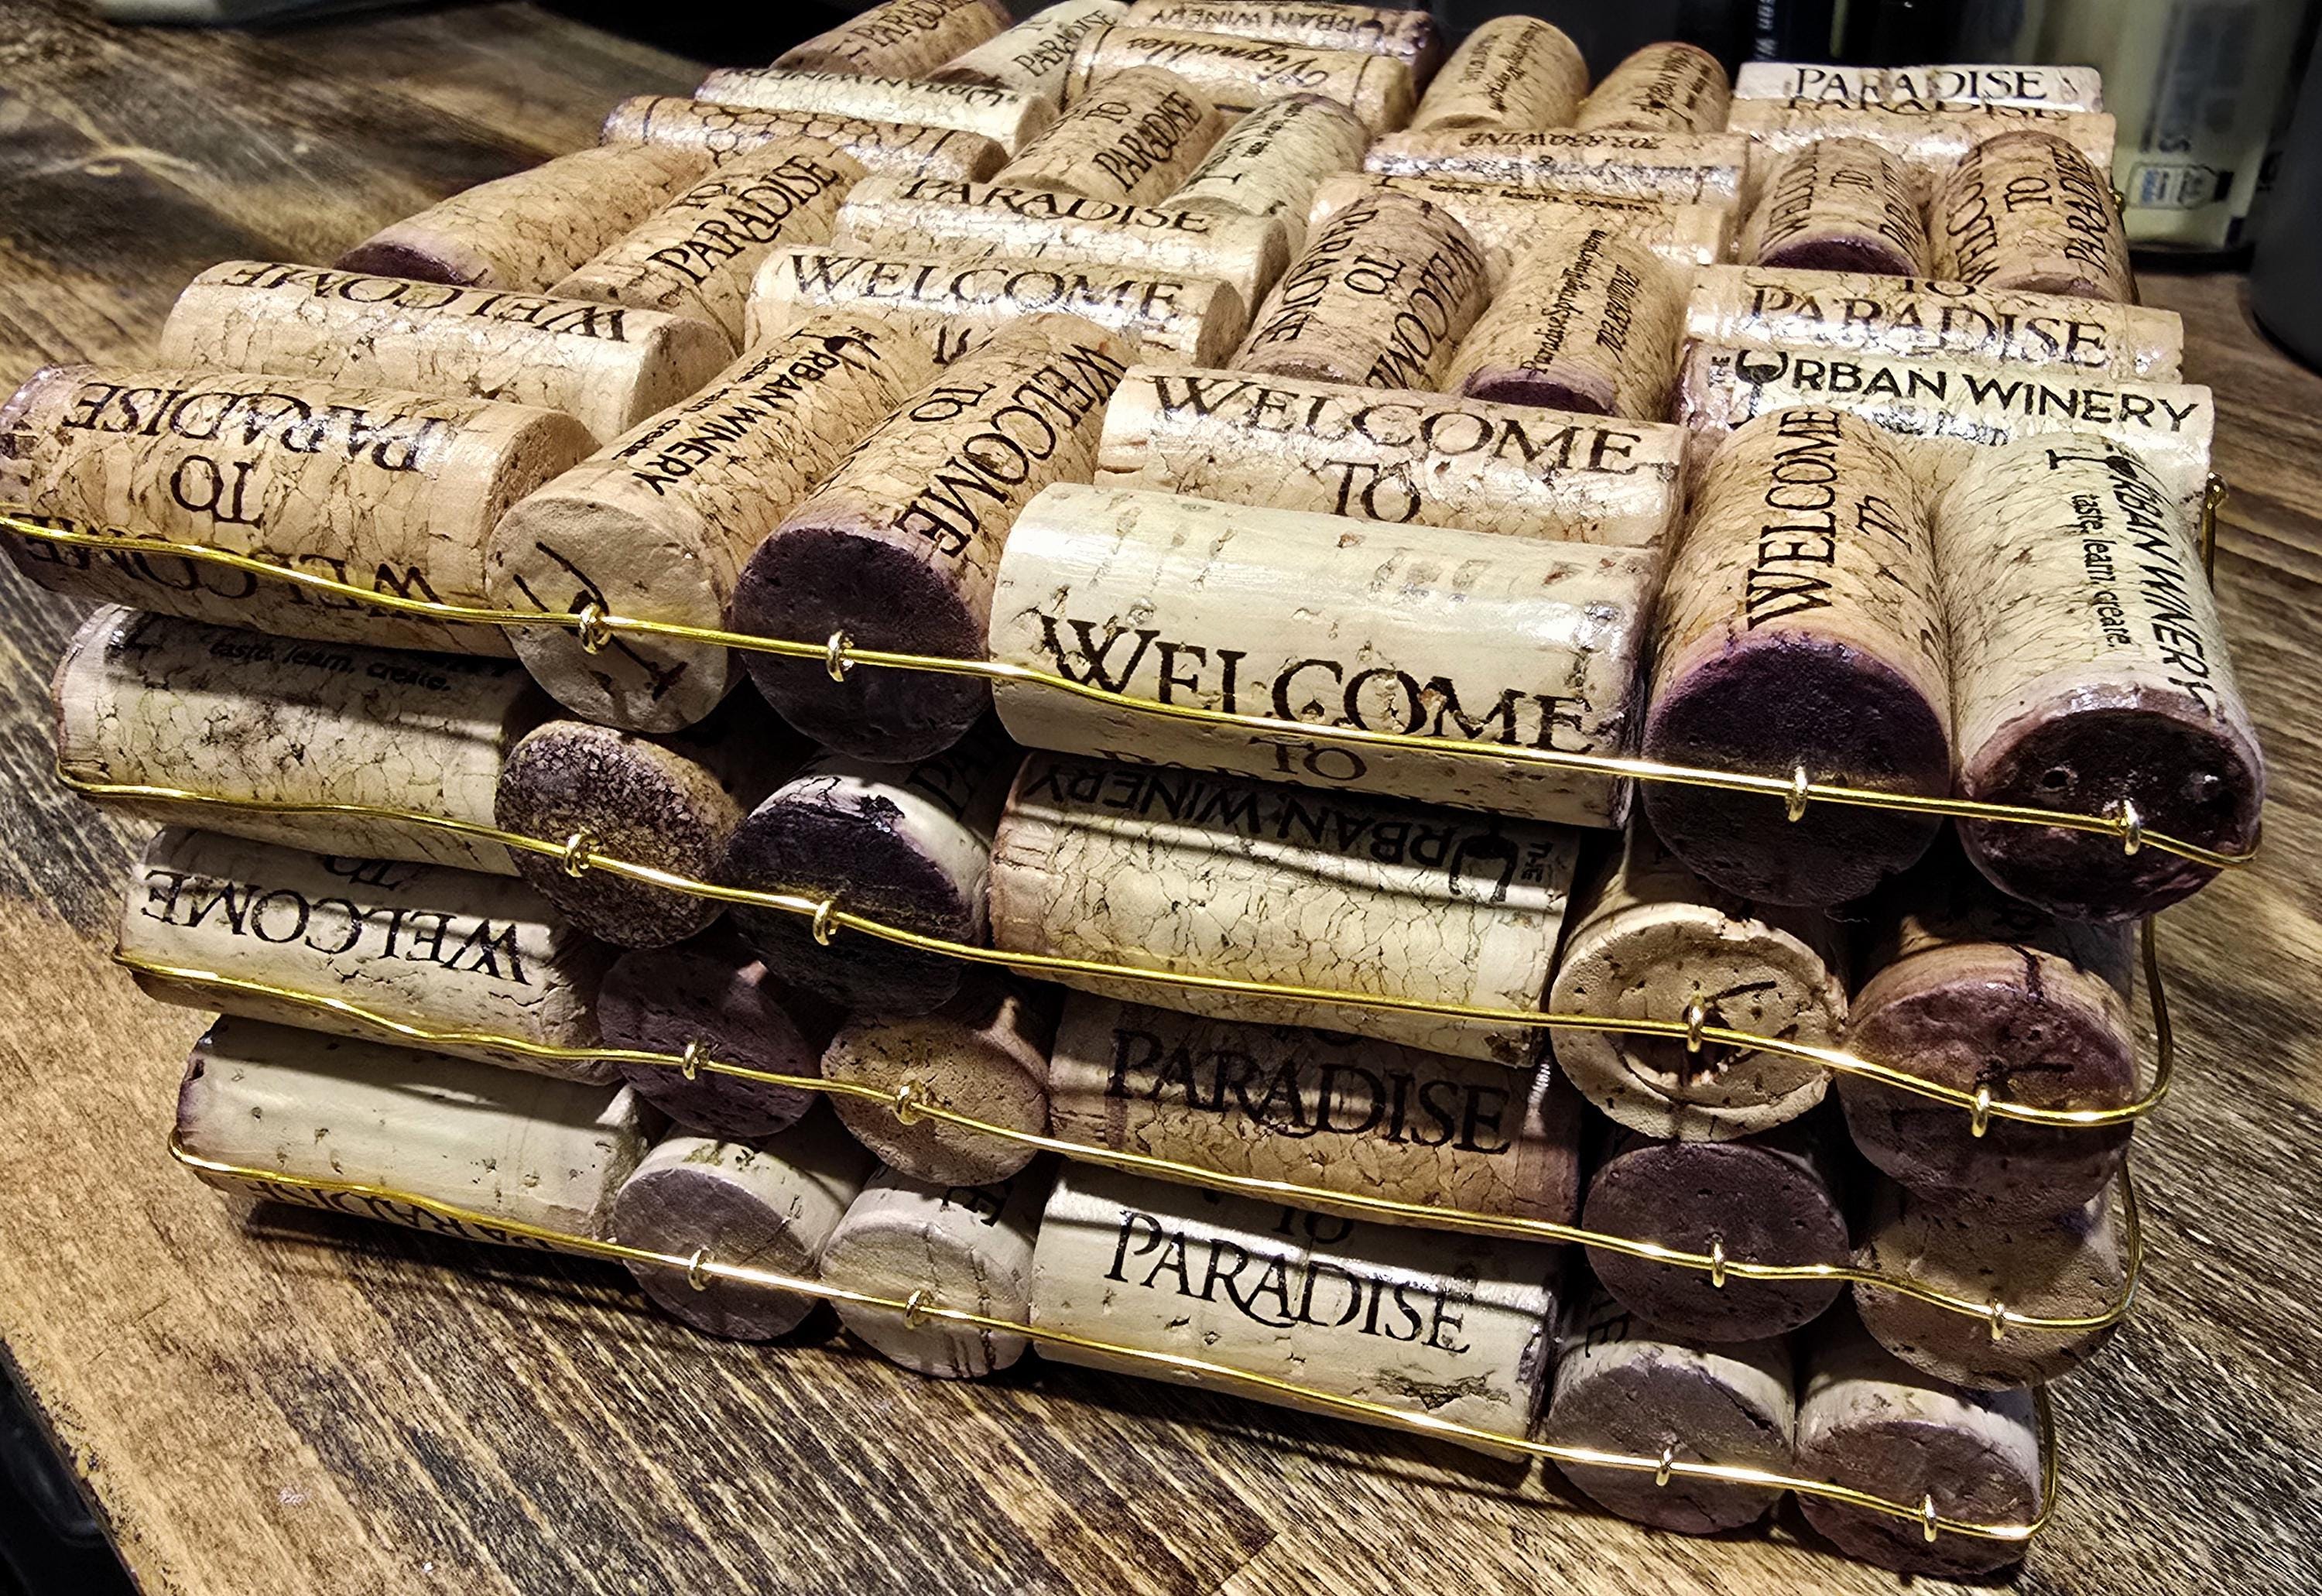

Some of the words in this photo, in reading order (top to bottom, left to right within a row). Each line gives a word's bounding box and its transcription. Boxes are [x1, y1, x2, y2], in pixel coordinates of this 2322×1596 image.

[1795, 68, 2050, 101] PARADISE
[1091, 90, 1203, 193] PARADISE
[646, 153, 837, 284] PARADISE
[899, 177, 1210, 233] PARADISE
[2003, 176, 2054, 213] TO
[219, 259, 628, 343] WELCOME
[789, 254, 1184, 321] WELCOME
[1343, 252, 1405, 296] TO
[1751, 283, 2107, 370] PARADISE
[63, 382, 450, 474] PARADISE
[909, 383, 997, 423] TO
[1152, 375, 1642, 474] WELCOME
[1961, 373, 2198, 435] WINERY
[170, 454, 265, 527] TO
[631, 404, 768, 496] WINERY
[893, 343, 1126, 556] WELCOME
[1325, 461, 1423, 524] TO
[1748, 409, 1842, 631] WELCOME
[2138, 563, 2217, 716] WINERY
[1039, 618, 1596, 755] WELCOME
[1023, 761, 1248, 832] WINERY
[1248, 735, 1370, 781] TO
[141, 868, 534, 988] WELCOME
[1103, 1028, 1512, 1156] PARADISE
[1102, 1211, 1472, 1356] PARADISE
